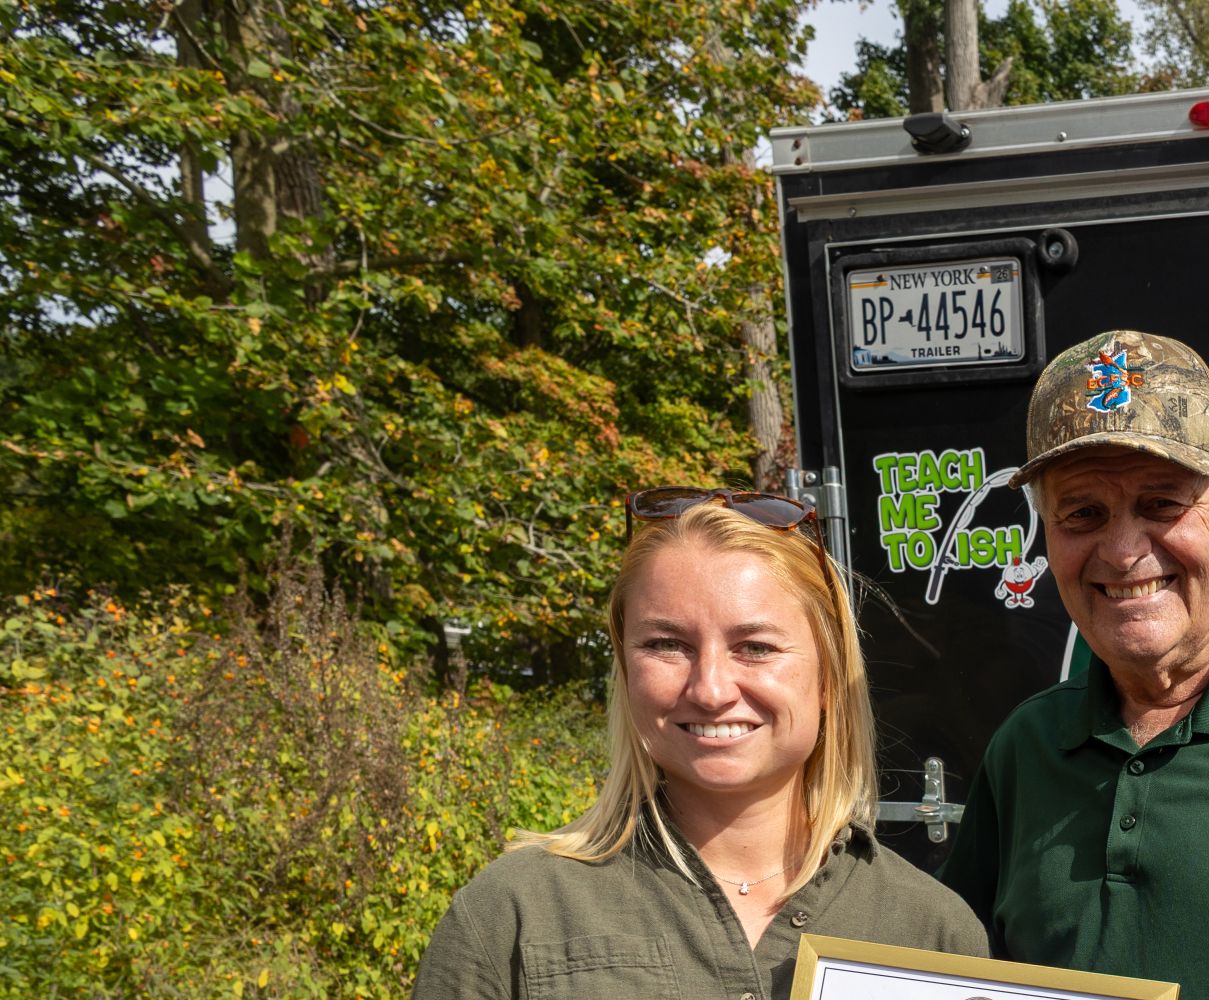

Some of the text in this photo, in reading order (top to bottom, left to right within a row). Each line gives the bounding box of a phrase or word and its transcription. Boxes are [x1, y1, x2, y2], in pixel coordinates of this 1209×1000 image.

[890, 268, 976, 290] NEW YORK
[996, 270, 1008, 280] 26
[862, 289, 1006, 346] BP 44546
[911, 346, 960, 358] TRAILER
[874, 450, 984, 493] TEACH
[879, 493, 940, 532] ME
[882, 531, 935, 570] TO
